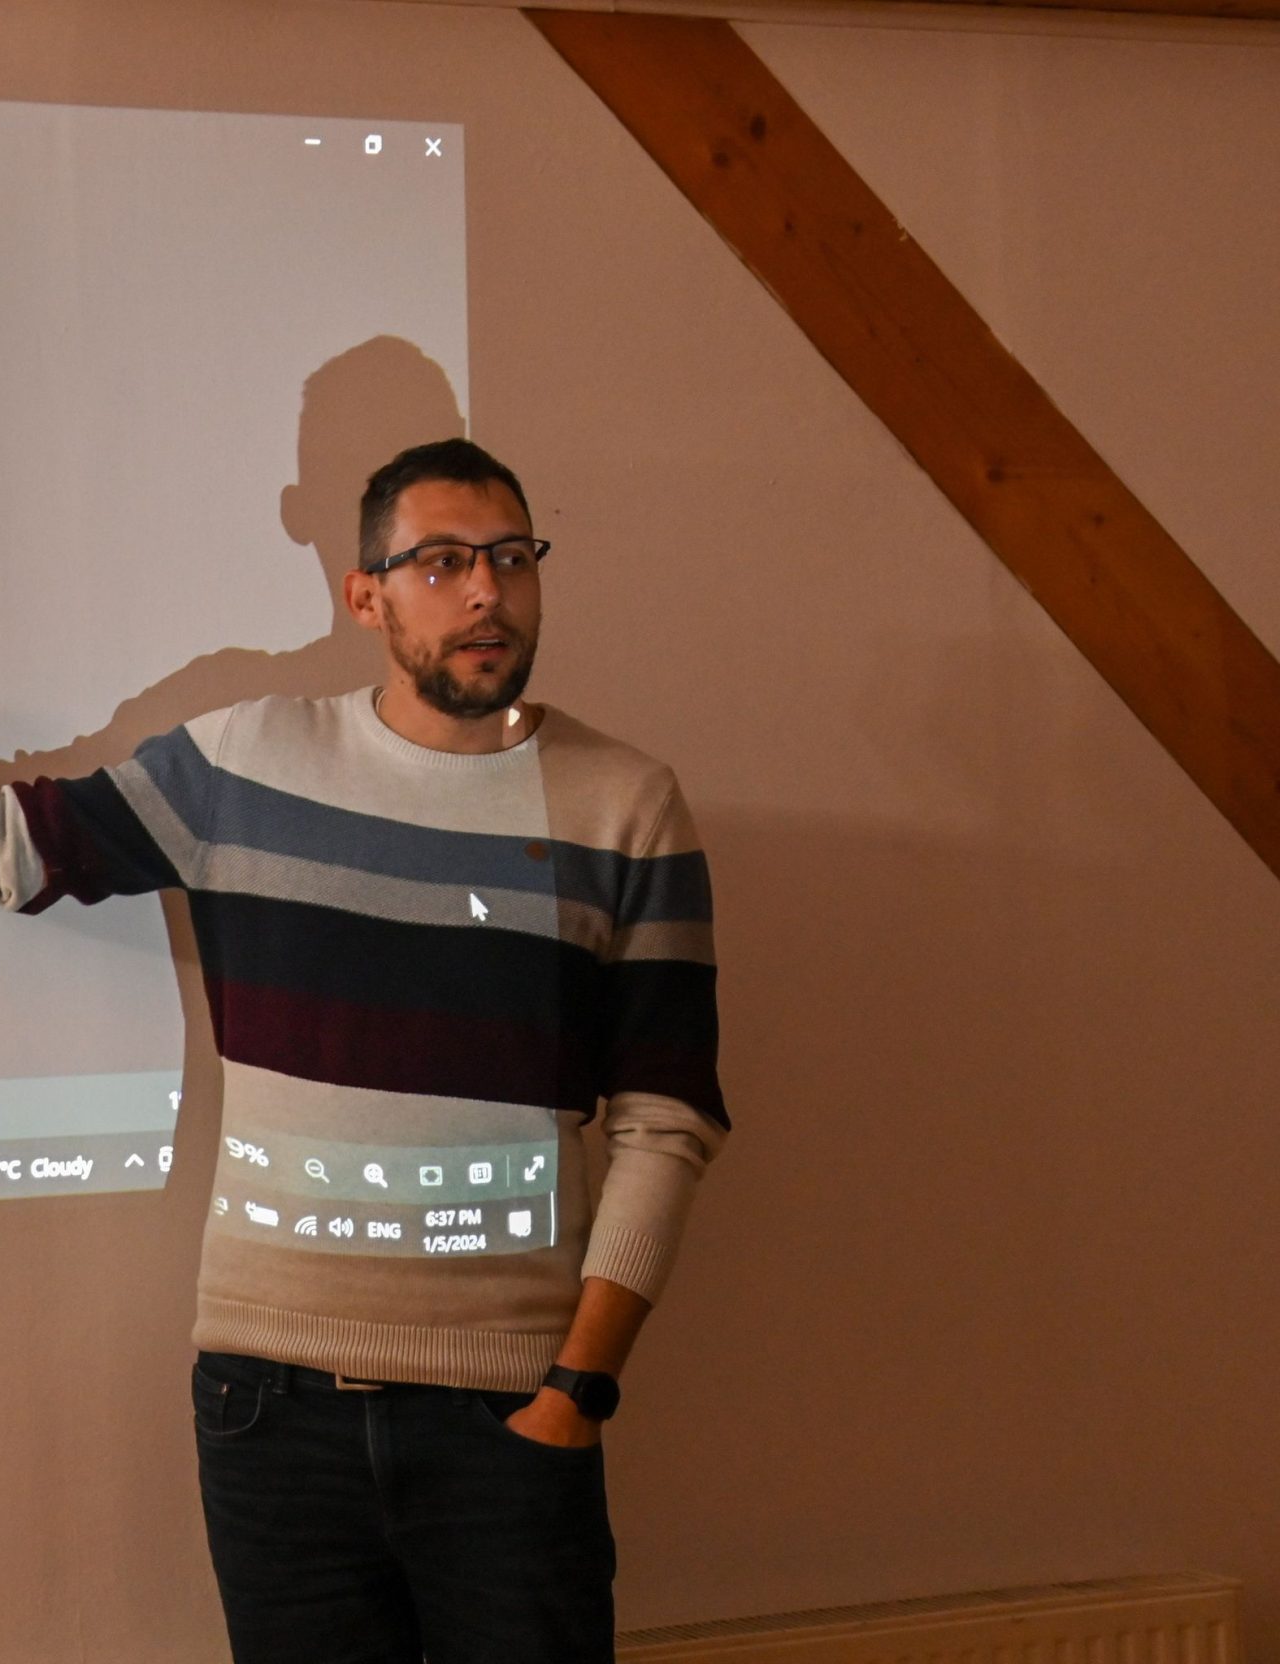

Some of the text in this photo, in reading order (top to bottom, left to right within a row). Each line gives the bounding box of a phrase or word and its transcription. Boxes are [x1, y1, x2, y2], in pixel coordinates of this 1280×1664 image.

[30, 1155, 93, 1180] Cloudy
[425, 1208, 481, 1227] 6:37 PM
[367, 1221, 402, 1239] ENG
[423, 1234, 486, 1253] 1/5/2024
